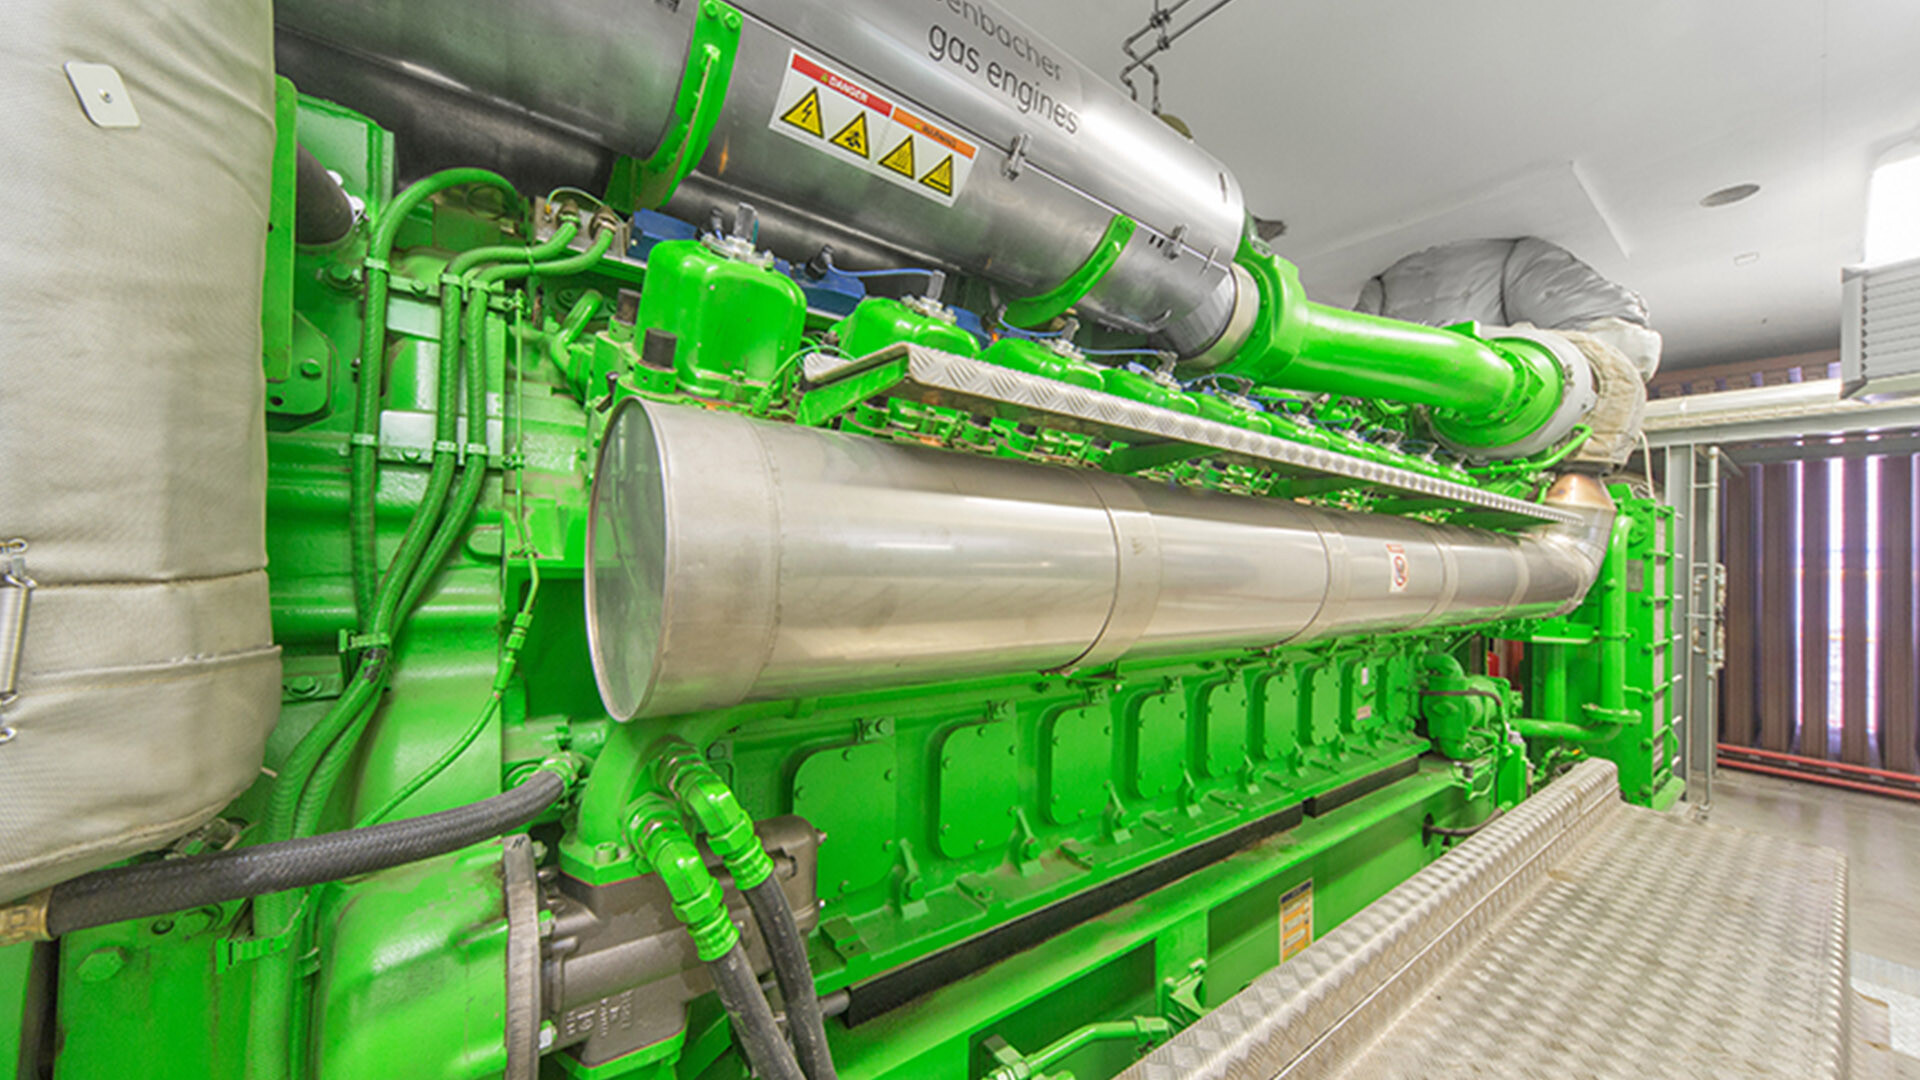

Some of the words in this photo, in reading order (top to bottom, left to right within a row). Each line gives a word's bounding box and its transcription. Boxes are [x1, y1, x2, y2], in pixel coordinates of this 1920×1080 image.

[929, 24, 980, 74] gas
[987, 61, 1078, 134] engines
[937, 0, 1061, 81] enbacher
[828, 76, 869, 104] DANGER
